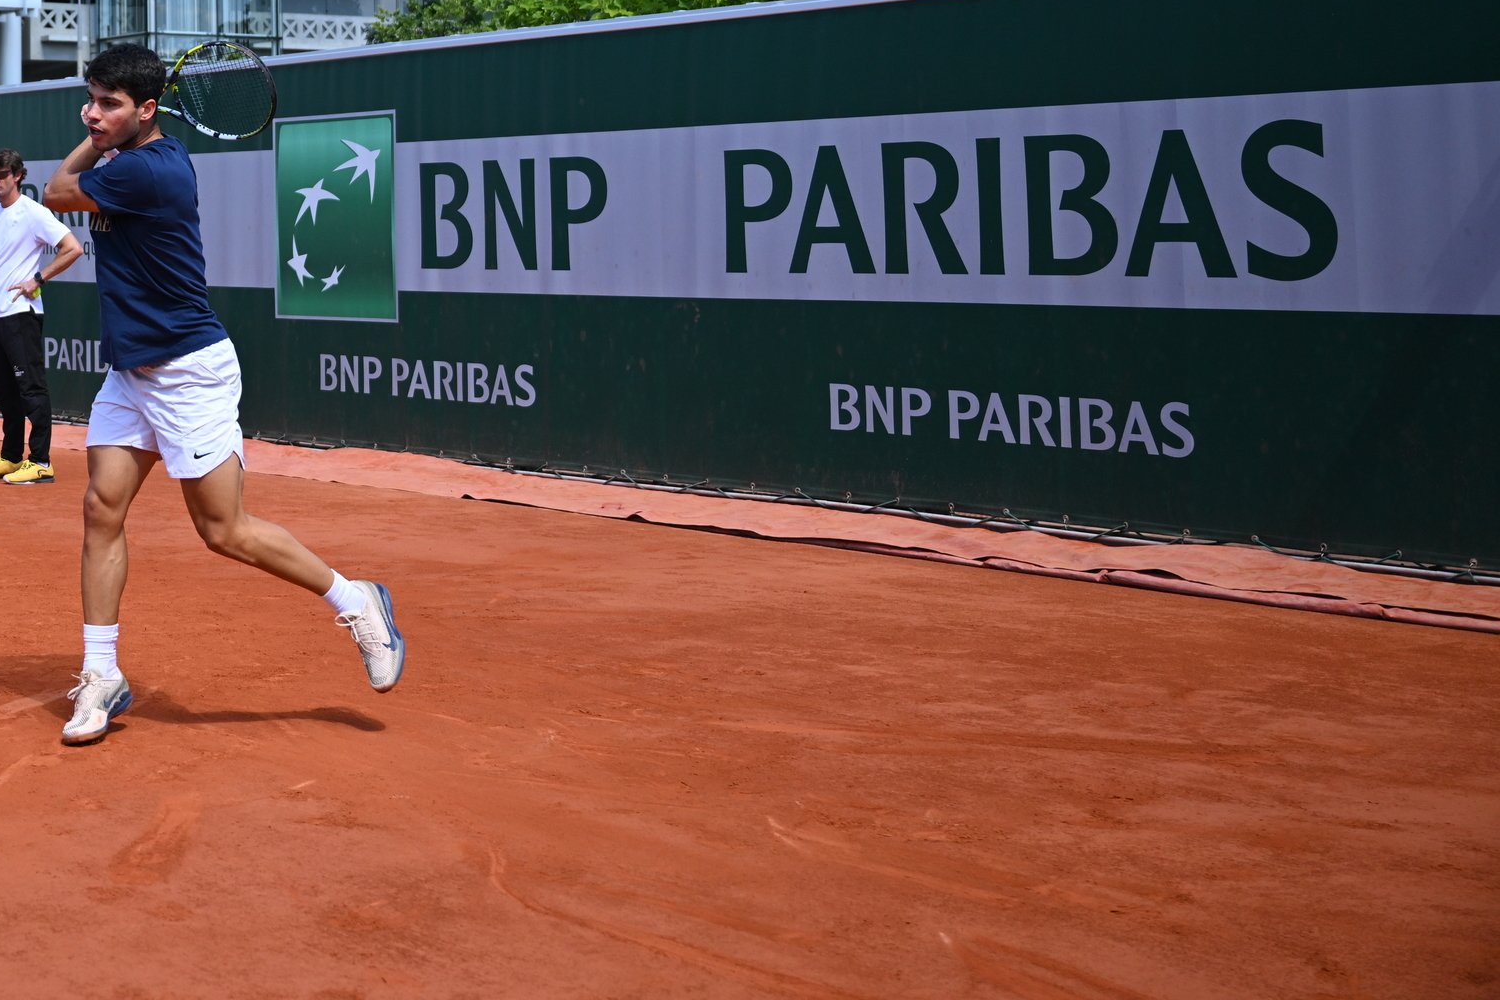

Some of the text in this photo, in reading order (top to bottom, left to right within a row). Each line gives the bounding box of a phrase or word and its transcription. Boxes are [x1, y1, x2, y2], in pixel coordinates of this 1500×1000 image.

[90, 211, 111, 232] IKE
[419, 118, 1339, 283] BNP PARIBAS
[83, 241, 96, 260] qu
[319, 353, 536, 408] BNP PARIBAS
[828, 383, 1196, 459] BNP PARIBAS
